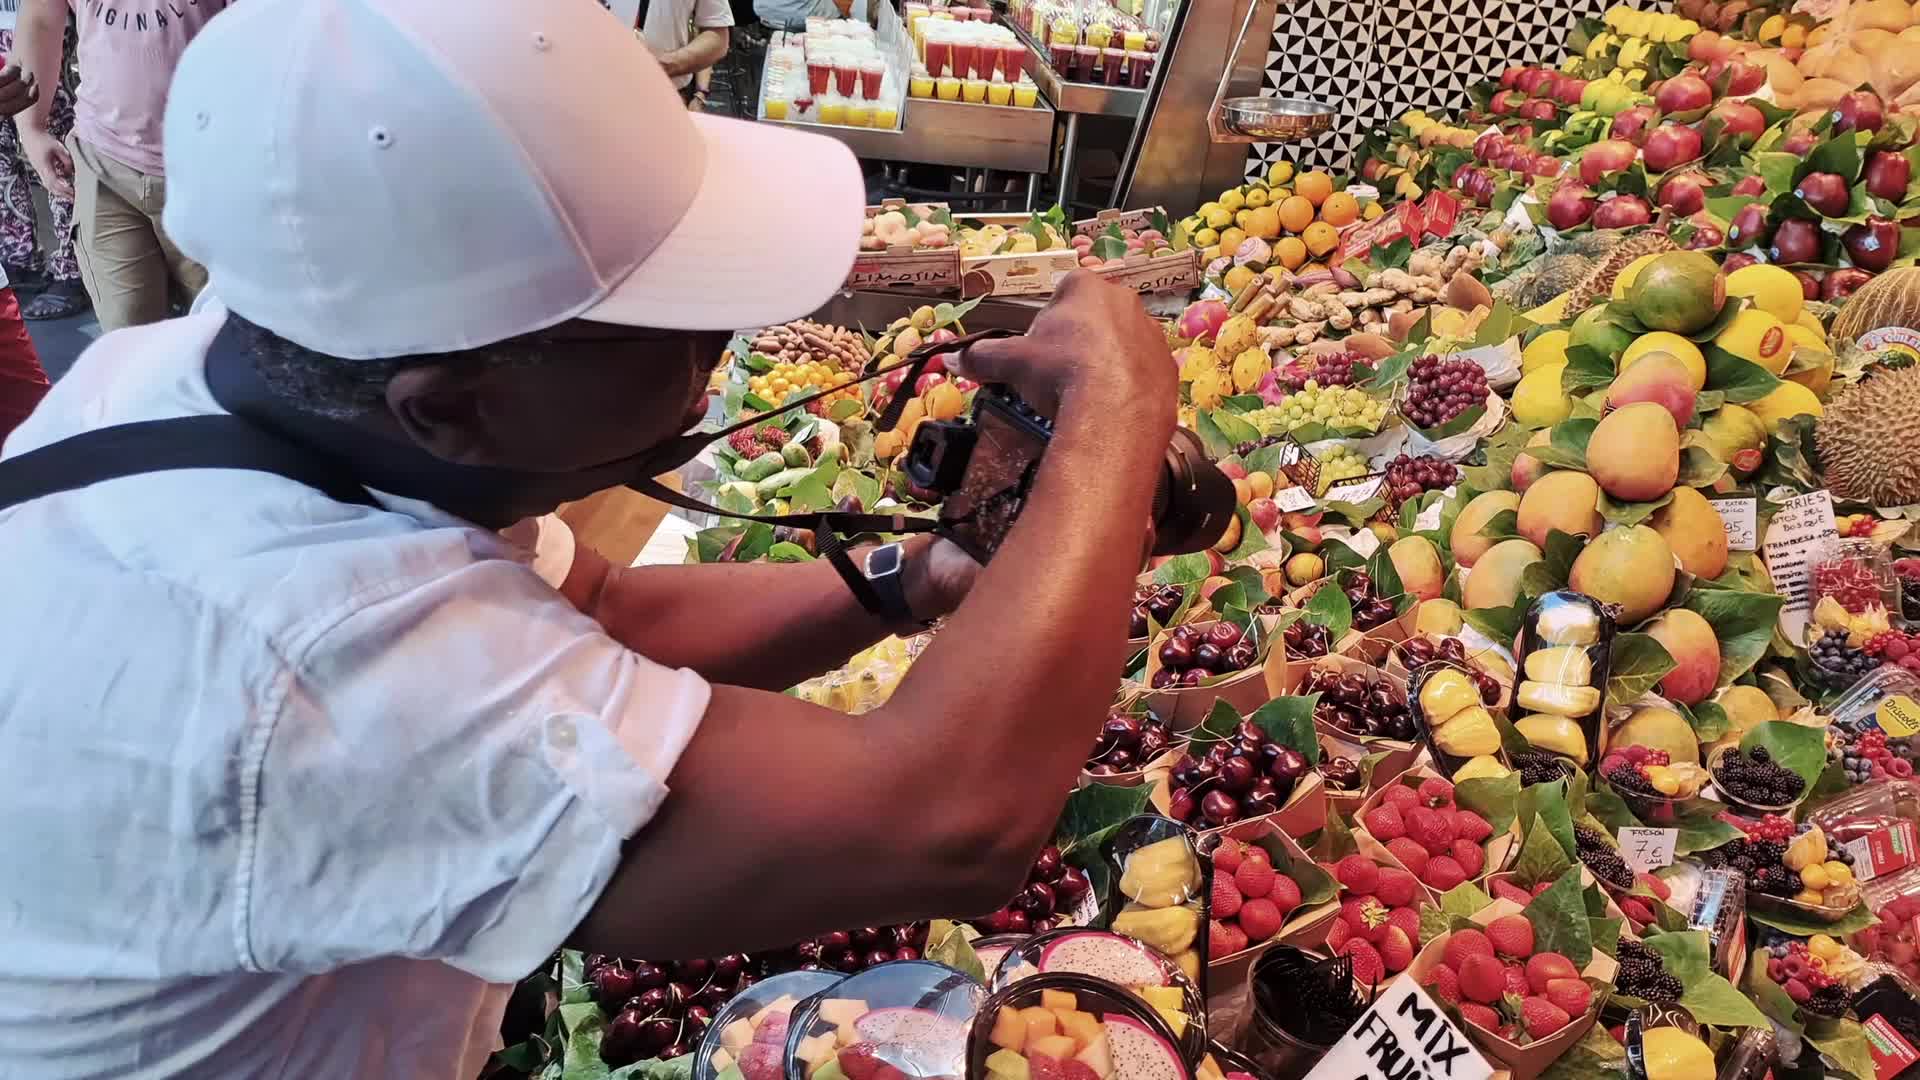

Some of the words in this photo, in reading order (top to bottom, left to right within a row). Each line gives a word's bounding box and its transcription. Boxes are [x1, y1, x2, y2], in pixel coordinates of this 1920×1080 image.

[853, 271, 947, 284] LIMOSIN
[1784, 491, 1827, 510] RRIES
[1635, 840, 1649, 859] 7
[1396, 991, 1470, 1076] MIX
